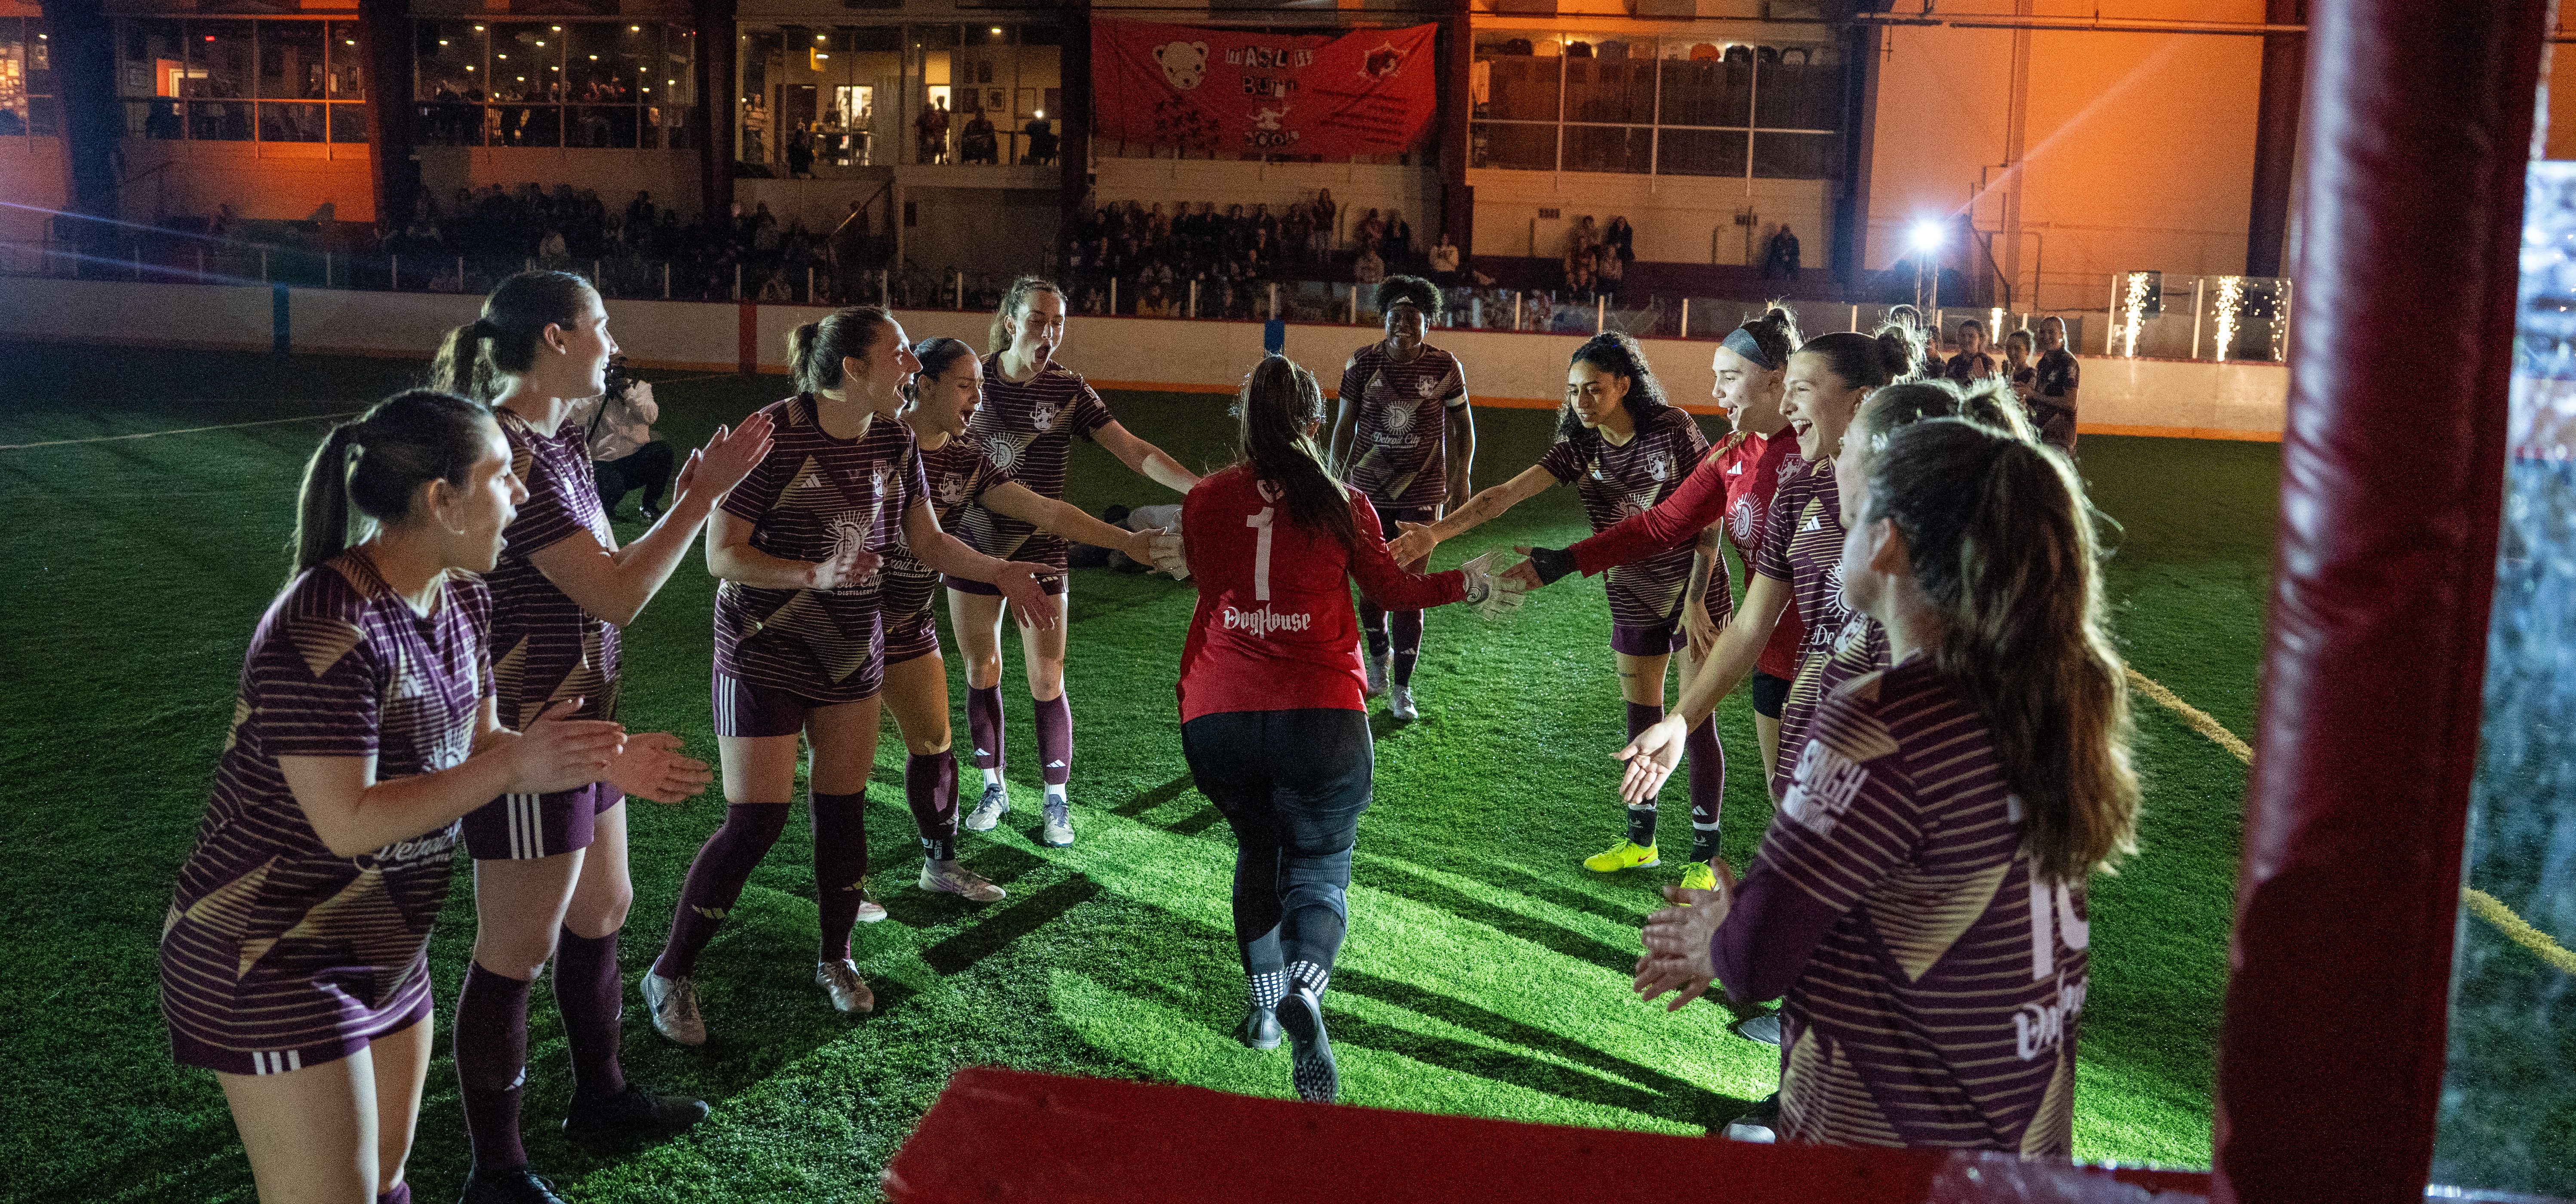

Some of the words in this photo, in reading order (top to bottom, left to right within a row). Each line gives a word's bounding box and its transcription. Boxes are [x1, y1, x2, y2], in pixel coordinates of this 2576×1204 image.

[1370, 431, 1404, 445] Detroit
[1404, 433, 1421, 448] City
[1246, 507, 1274, 601] 1
[1222, 603, 1311, 639] DogHouse
